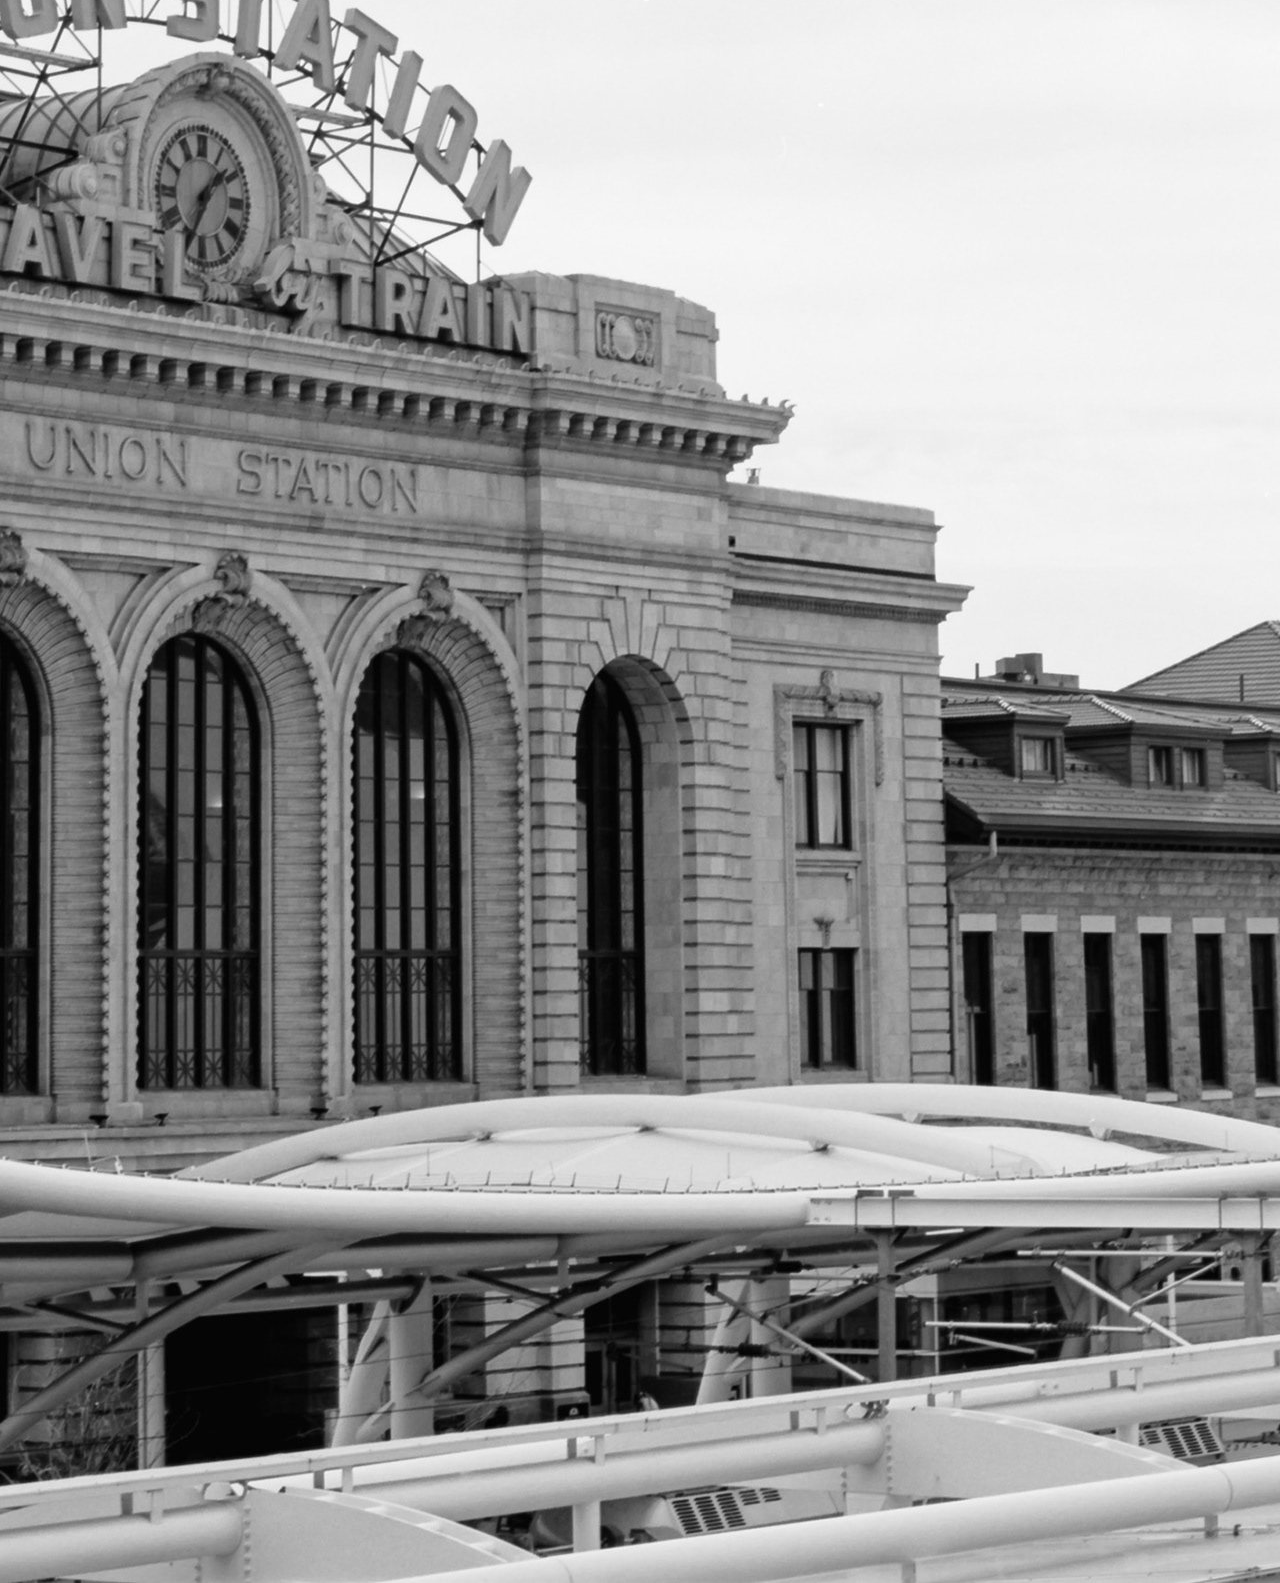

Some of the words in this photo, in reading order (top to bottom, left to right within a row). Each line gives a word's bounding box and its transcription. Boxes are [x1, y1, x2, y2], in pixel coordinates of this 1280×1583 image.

[254, 243, 326, 335] by
[331, 259, 532, 355] TRAIN
[26, 420, 187, 488] UNION
[236, 448, 418, 514] STATION
